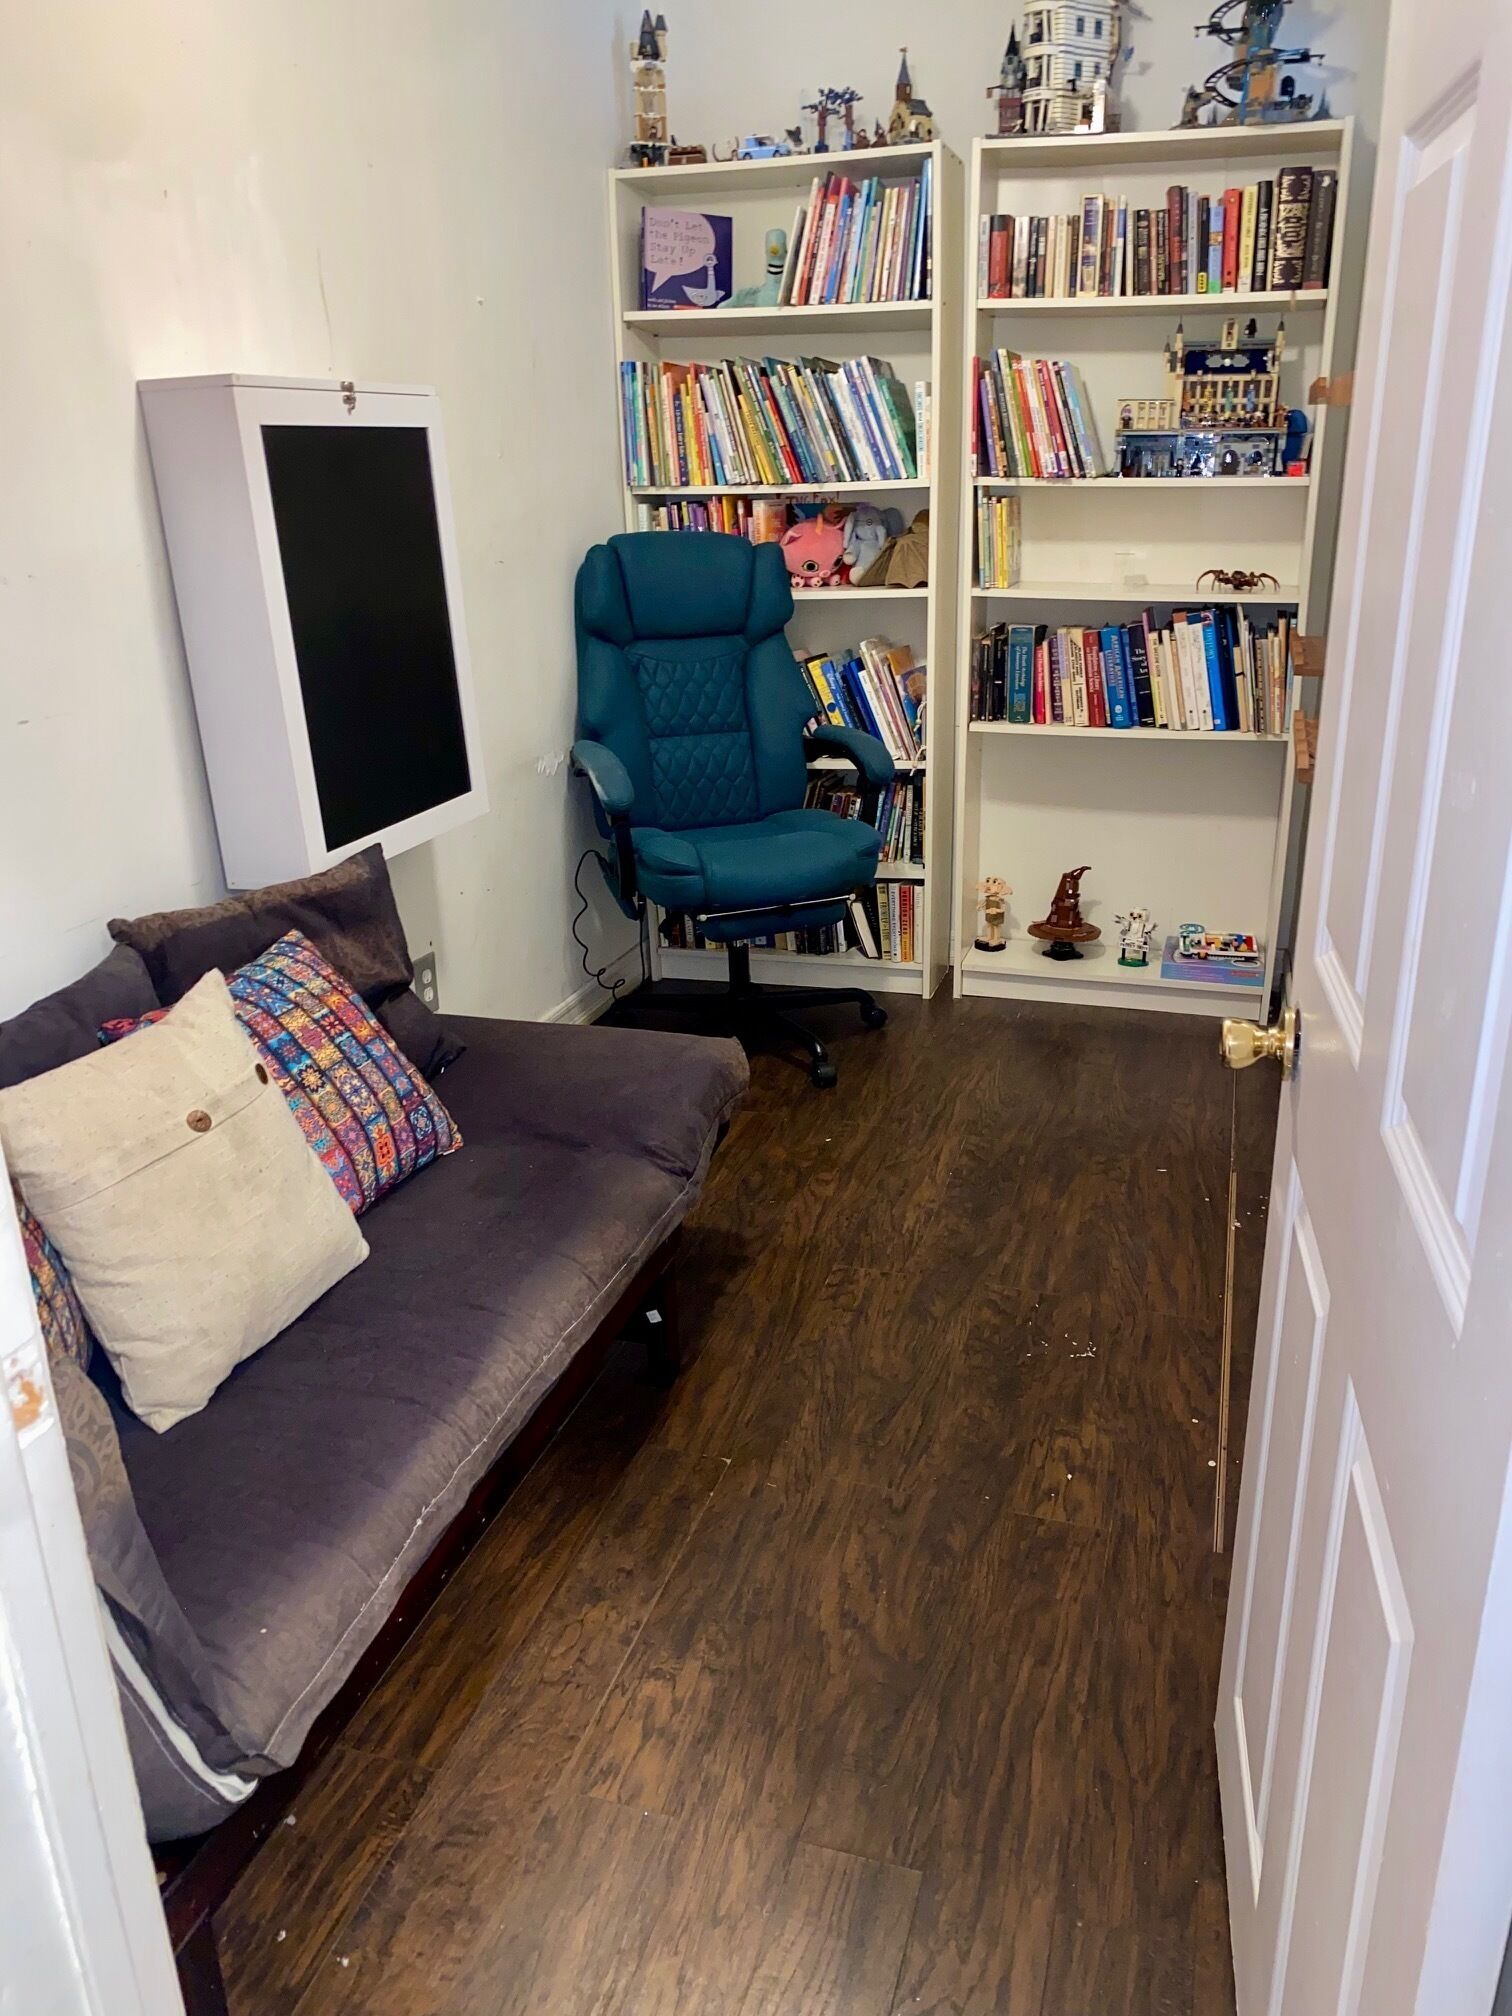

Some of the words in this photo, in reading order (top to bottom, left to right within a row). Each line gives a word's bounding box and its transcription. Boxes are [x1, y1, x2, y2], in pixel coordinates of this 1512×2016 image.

[649, 217, 680, 229] Don't
[685, 221, 703, 231] Let
[650, 230, 668, 240] the
[673, 232, 710, 245] Pigeon
[650, 242, 676, 256] Stay
[681, 245, 696, 257] Up
[650, 255, 684, 266] Late!
